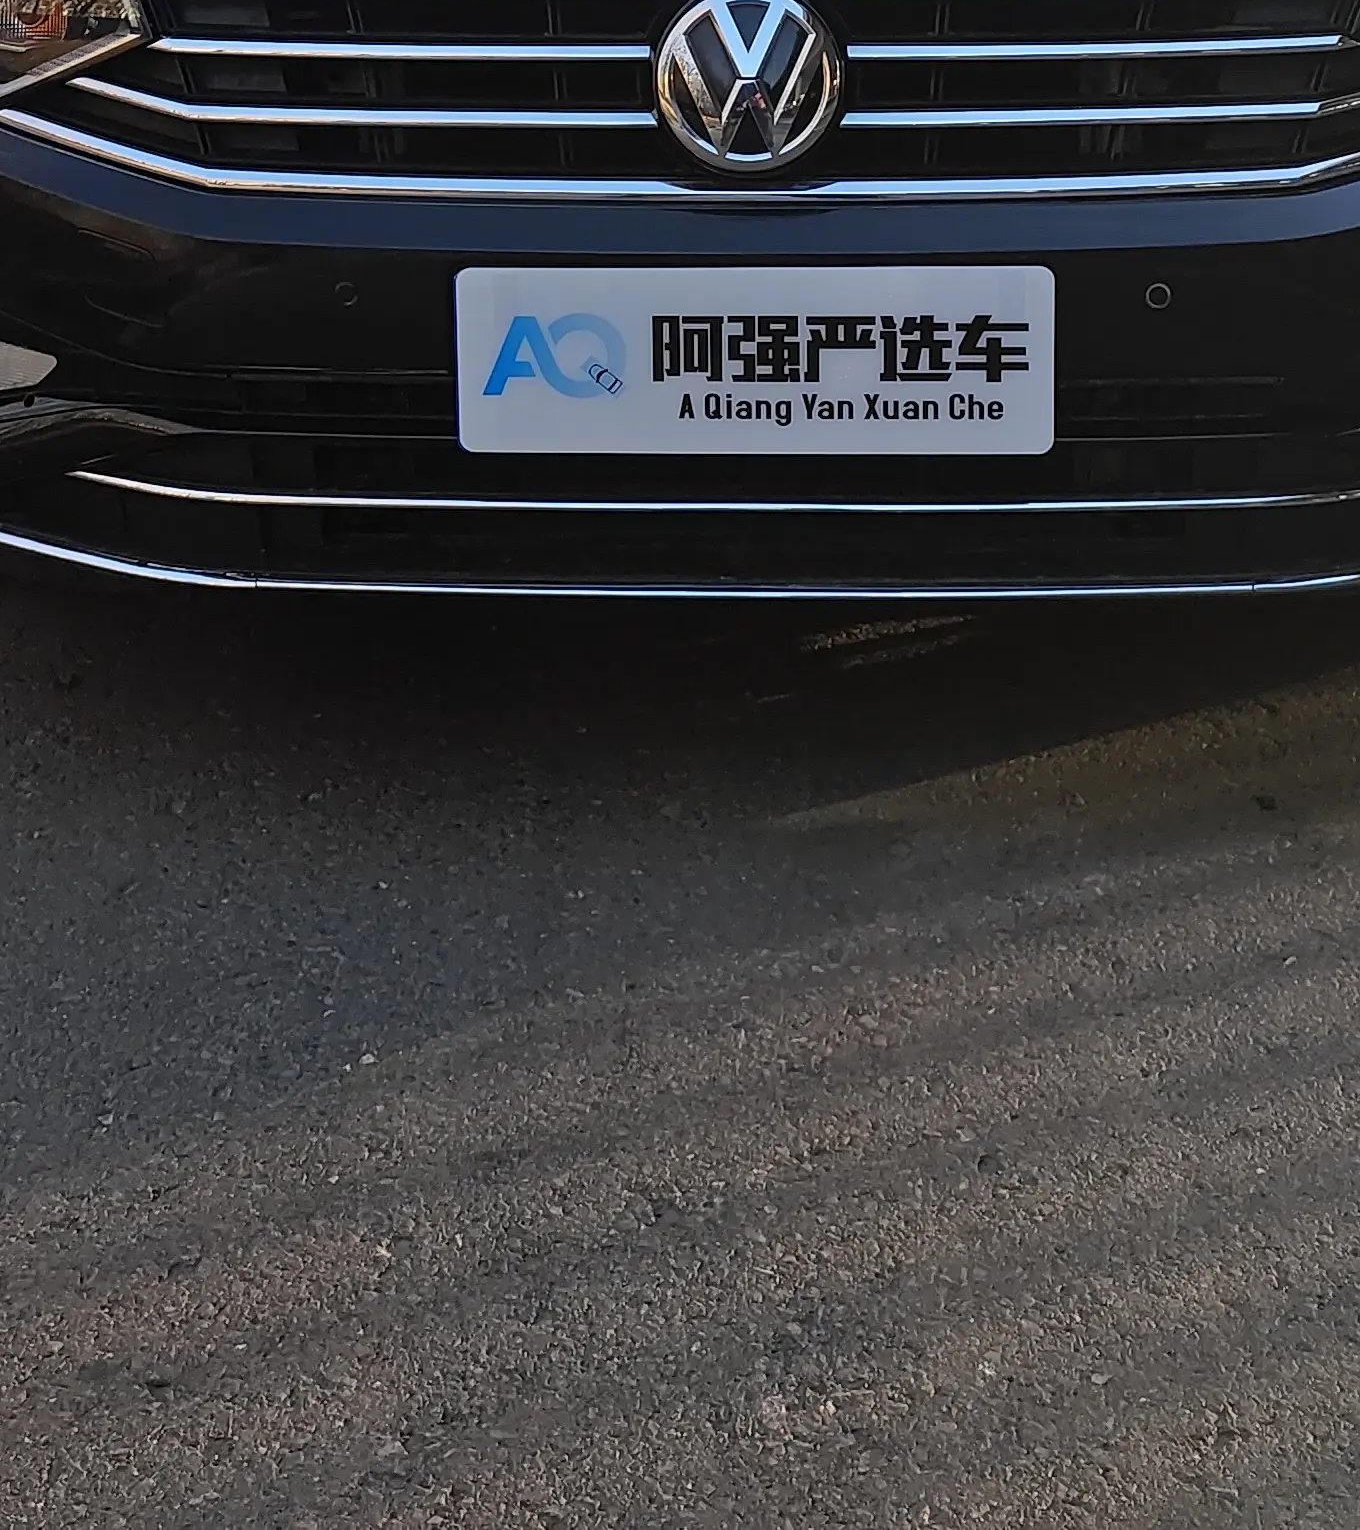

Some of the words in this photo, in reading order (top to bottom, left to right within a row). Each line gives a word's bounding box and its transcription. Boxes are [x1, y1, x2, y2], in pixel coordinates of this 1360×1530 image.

[482, 312, 627, 400] AQ
[651, 314, 1030, 383] 阿强严选车
[678, 393, 696, 420] A
[704, 392, 792, 427] Qiang
[801, 393, 854, 420] Yan
[863, 393, 940, 420] Xuan
[948, 393, 1004, 421] Che
